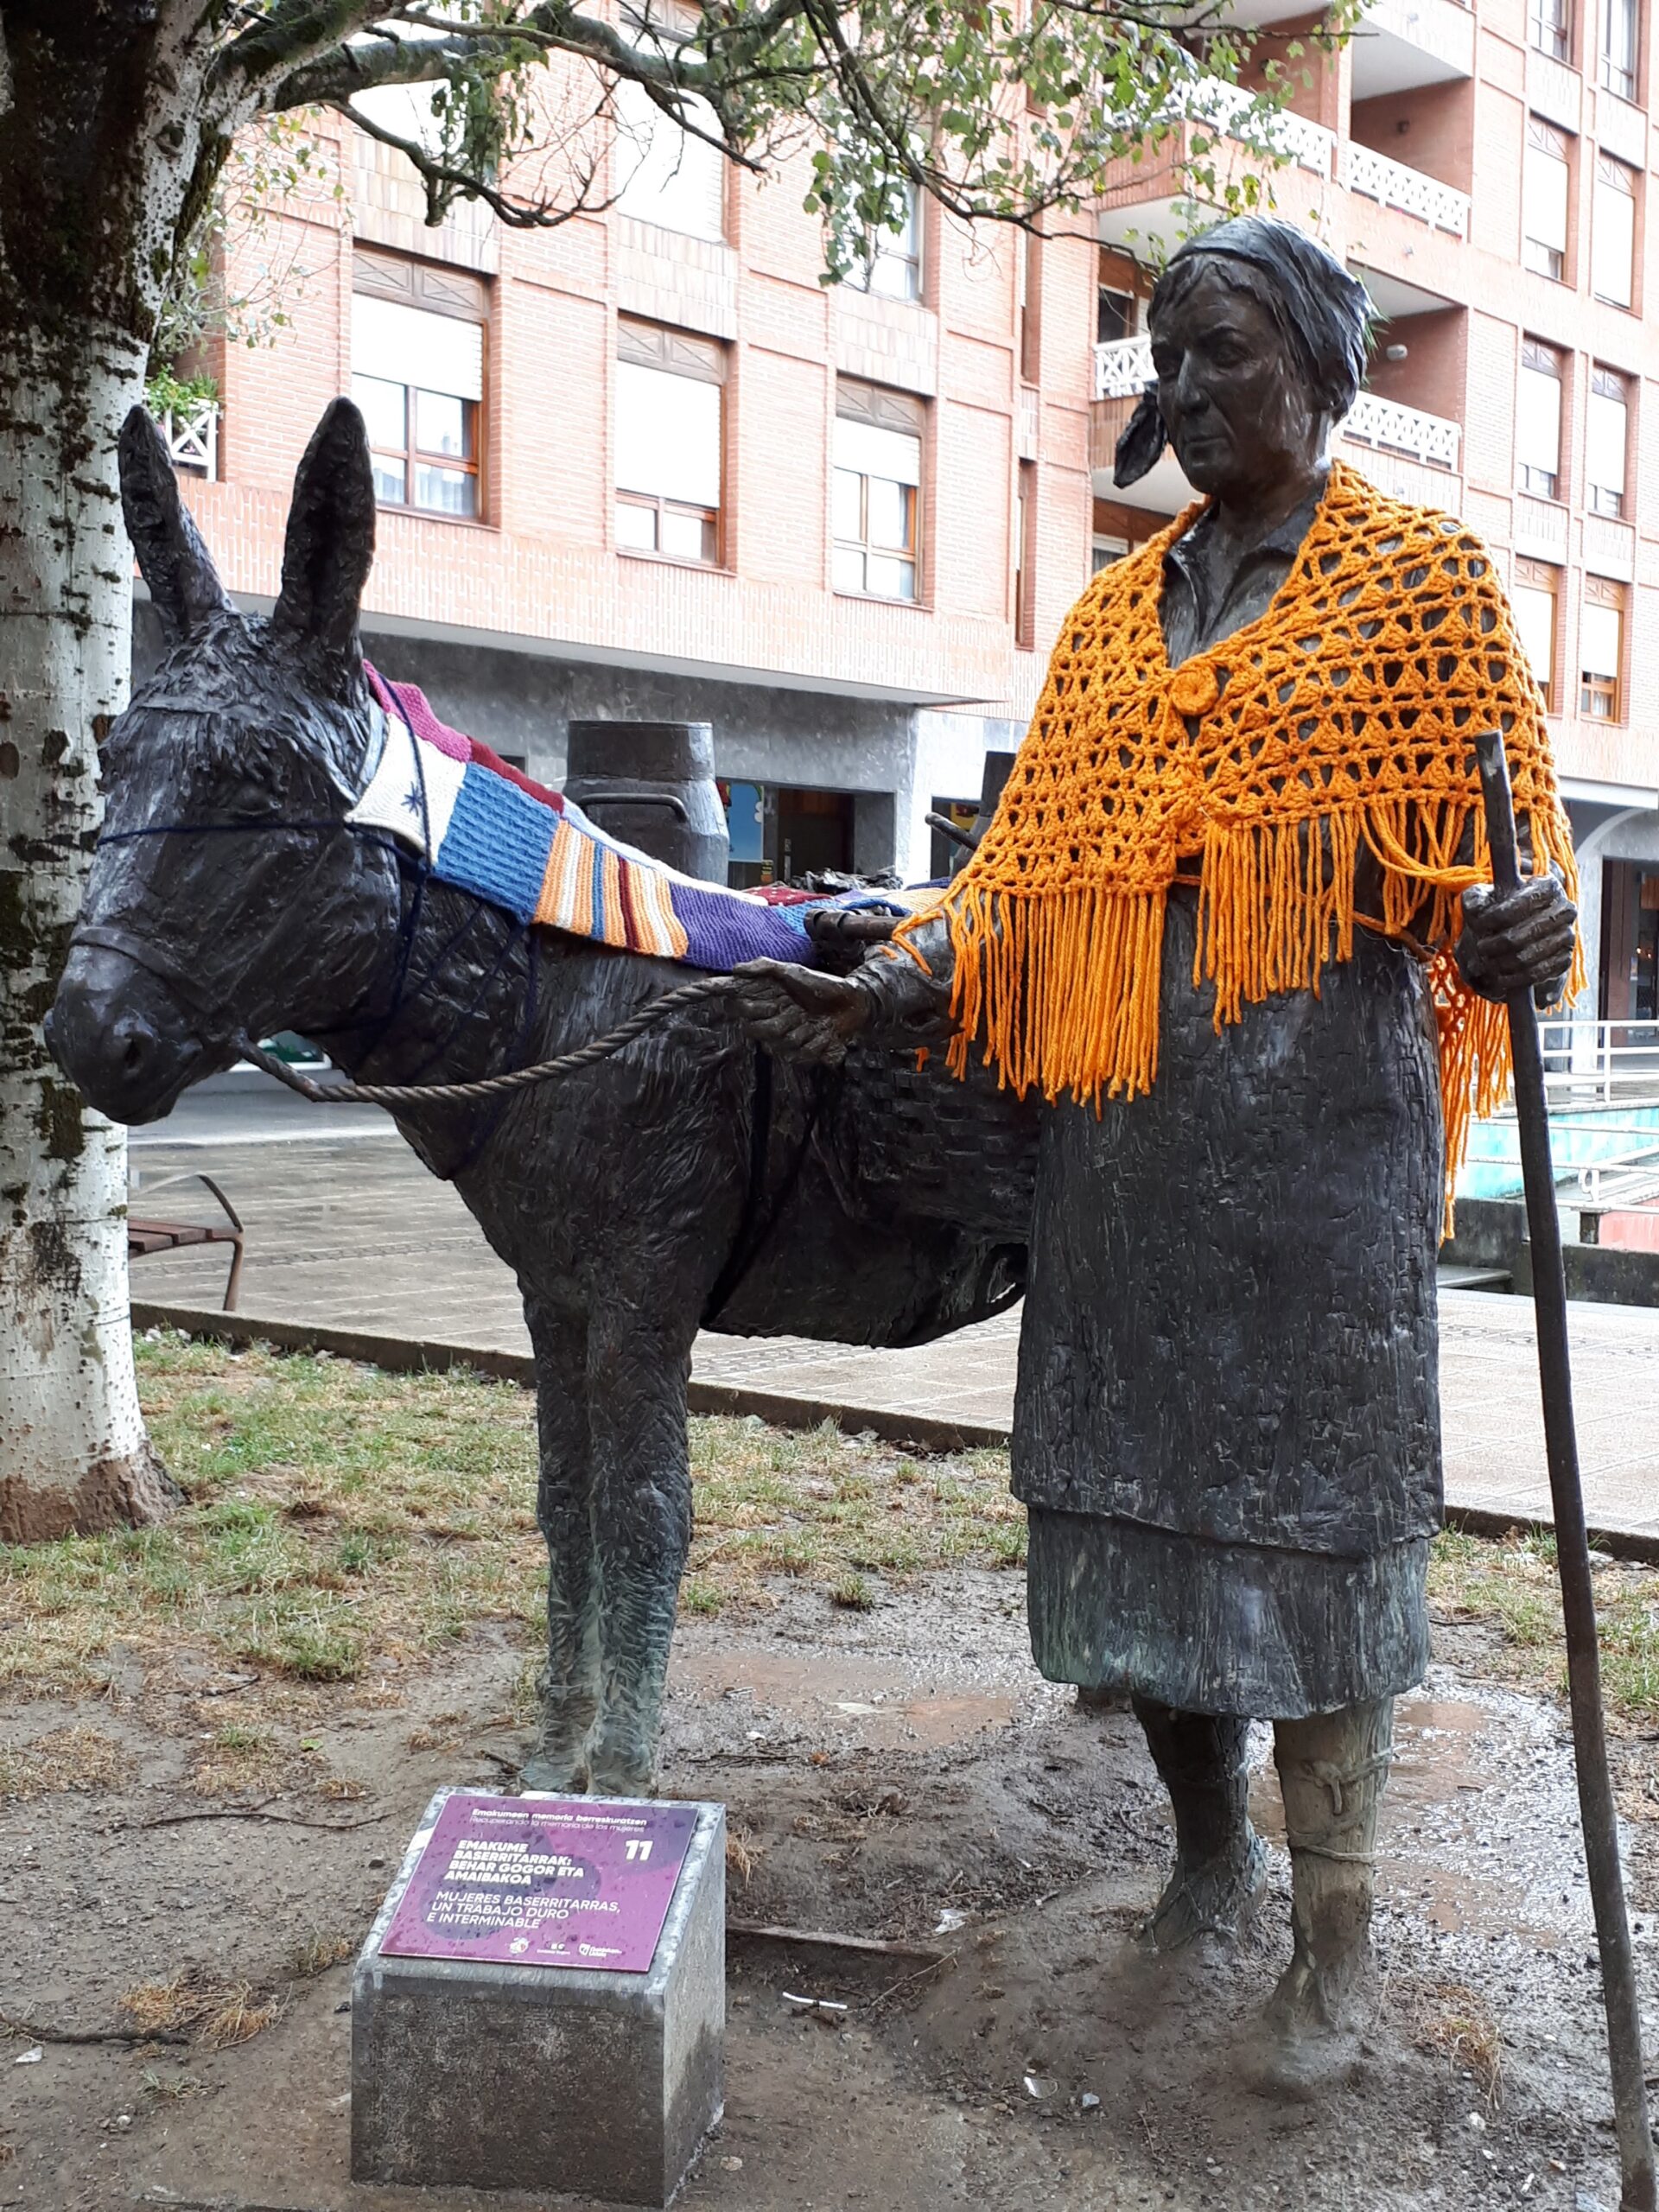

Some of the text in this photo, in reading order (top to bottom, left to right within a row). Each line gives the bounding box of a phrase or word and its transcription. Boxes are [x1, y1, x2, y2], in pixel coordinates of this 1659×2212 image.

[469, 1815, 529, 1827] Recuperando
[541, 1821, 581, 1829] memoria
[609, 1825, 645, 1834] mujeres
[472, 1808, 647, 1826] Emakumeen memoria berreskuratzen
[457, 1840, 528, 1853] EMAKUME
[625, 1840, 653, 1860] 11
[454, 1850, 572, 1866] BASERRITARRAK:
[448, 1859, 584, 1878] BEHAR GOGOR ETA
[443, 1871, 531, 1885] AMAIBAKOA
[431, 1902, 569, 1919] UN TRABAJO DURO
[435, 1891, 620, 1913] MUJERES BASERRITARRAS,
[426, 1912, 542, 1929] E INTERMINABLE
